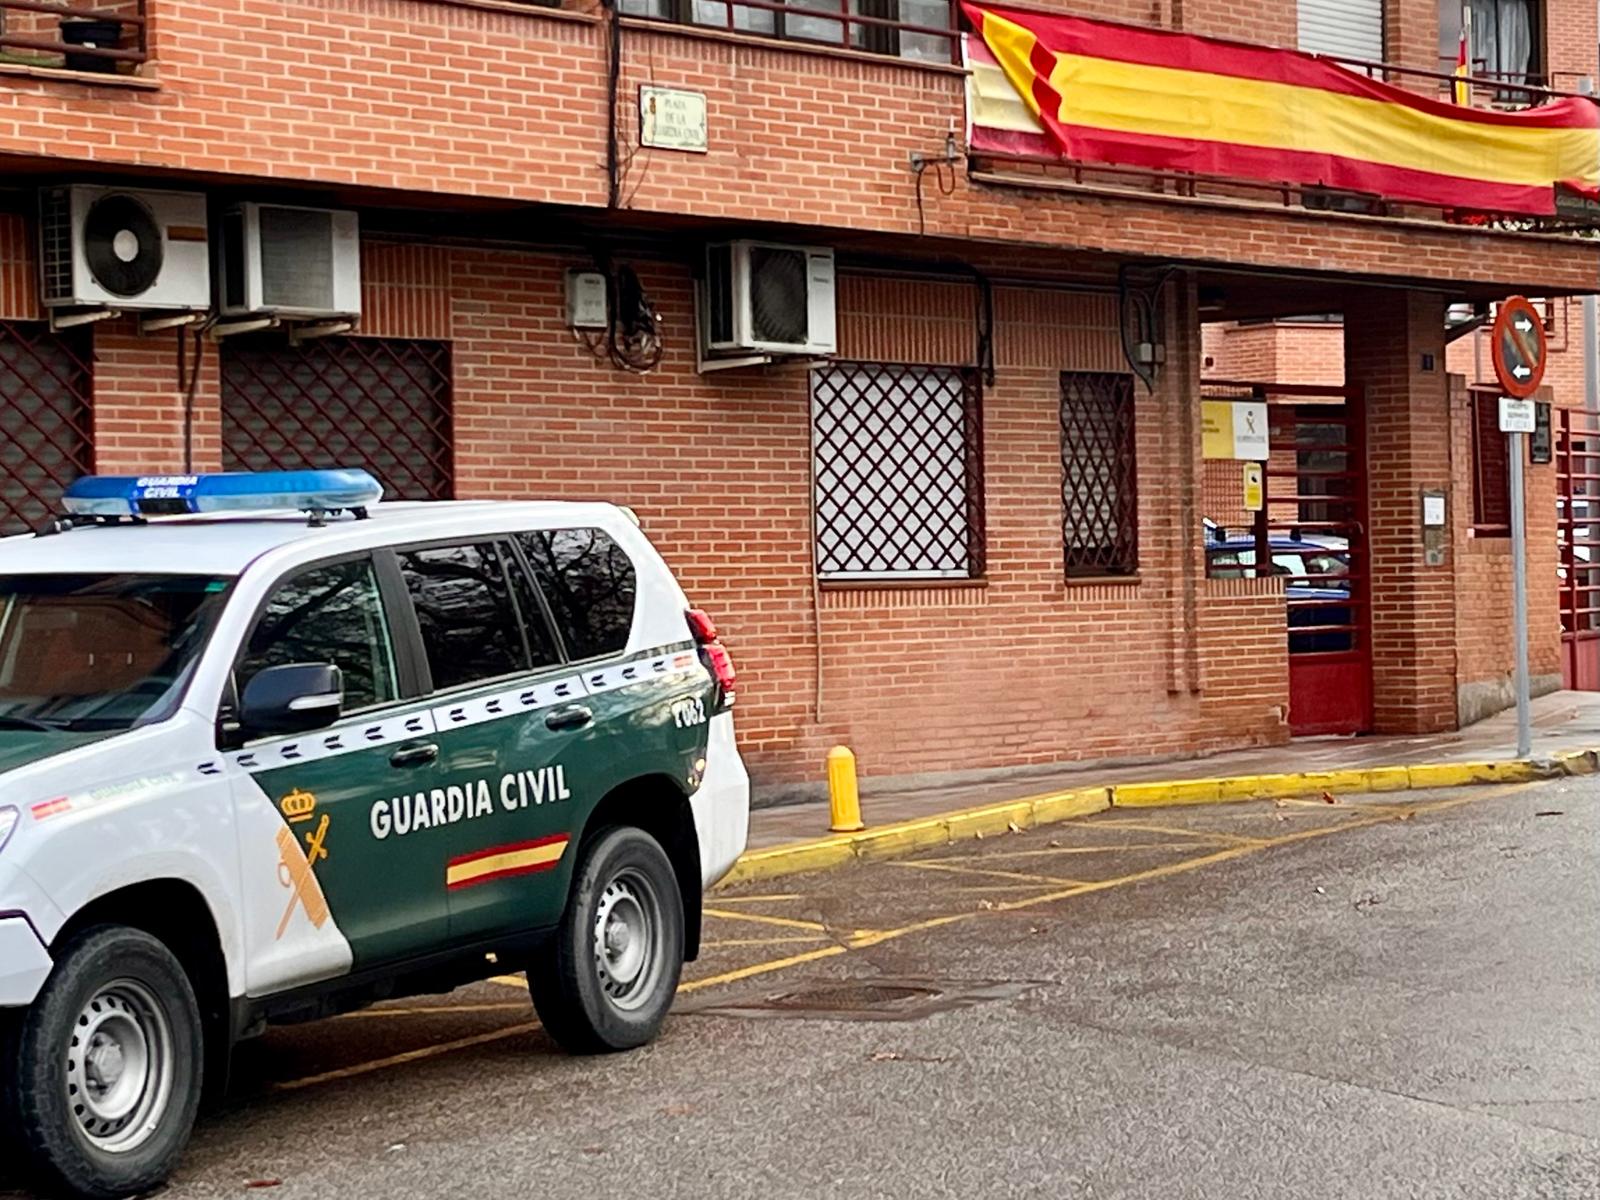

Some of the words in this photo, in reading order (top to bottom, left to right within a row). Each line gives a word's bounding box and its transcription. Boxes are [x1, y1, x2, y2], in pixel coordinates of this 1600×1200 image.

[136, 476, 198, 488] GUARDIA
[143, 486, 181, 498] CIVIL
[370, 779, 494, 839] GUARDIA
[500, 764, 571, 811] CIVIL
